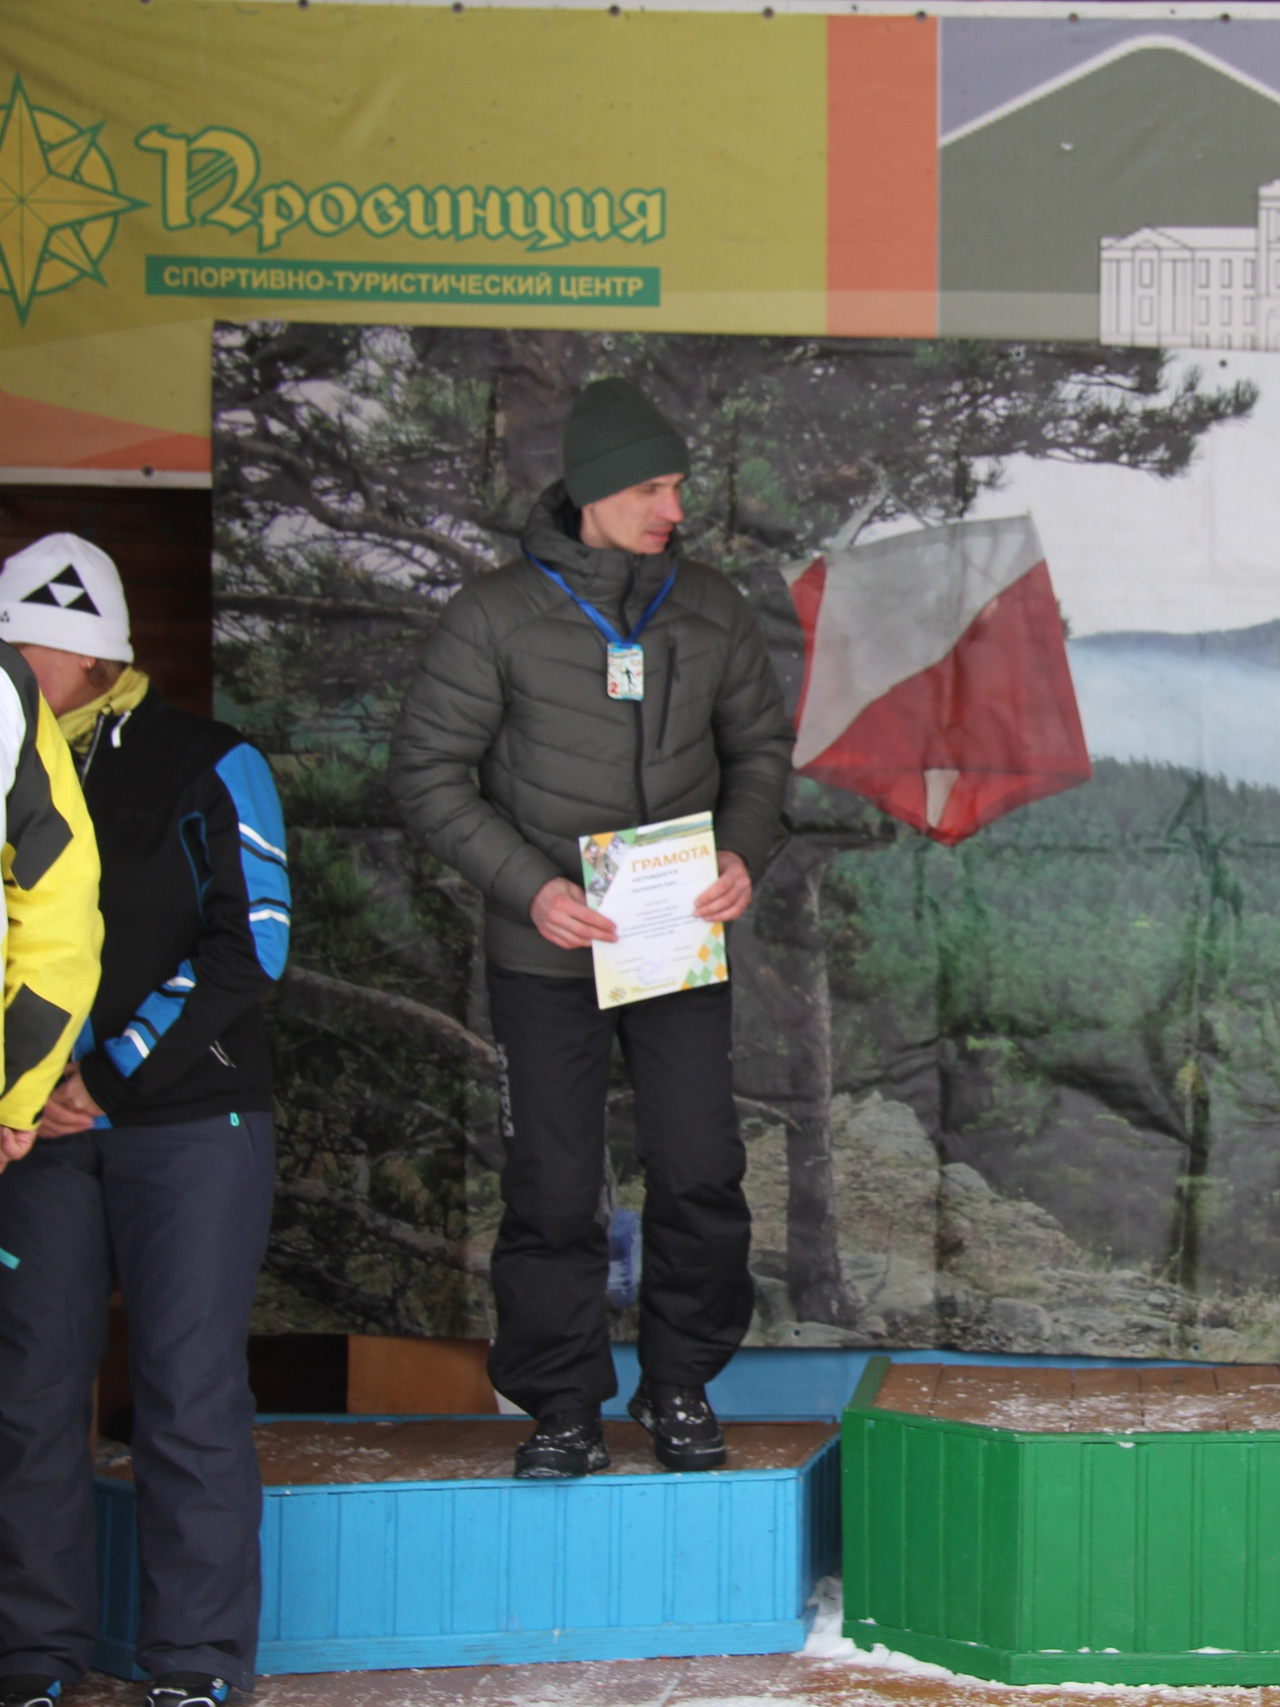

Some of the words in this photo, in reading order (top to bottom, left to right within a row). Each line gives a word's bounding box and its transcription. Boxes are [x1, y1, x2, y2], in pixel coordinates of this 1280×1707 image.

[134, 124, 666, 253] Провинция
[163, 266, 552, 295] СПОРТИВНО-ТУРИСТИЧЕСКИЙ
[559, 276, 644, 299] ЦЕНТР
[631, 845, 710, 874] ГРАМОТА
